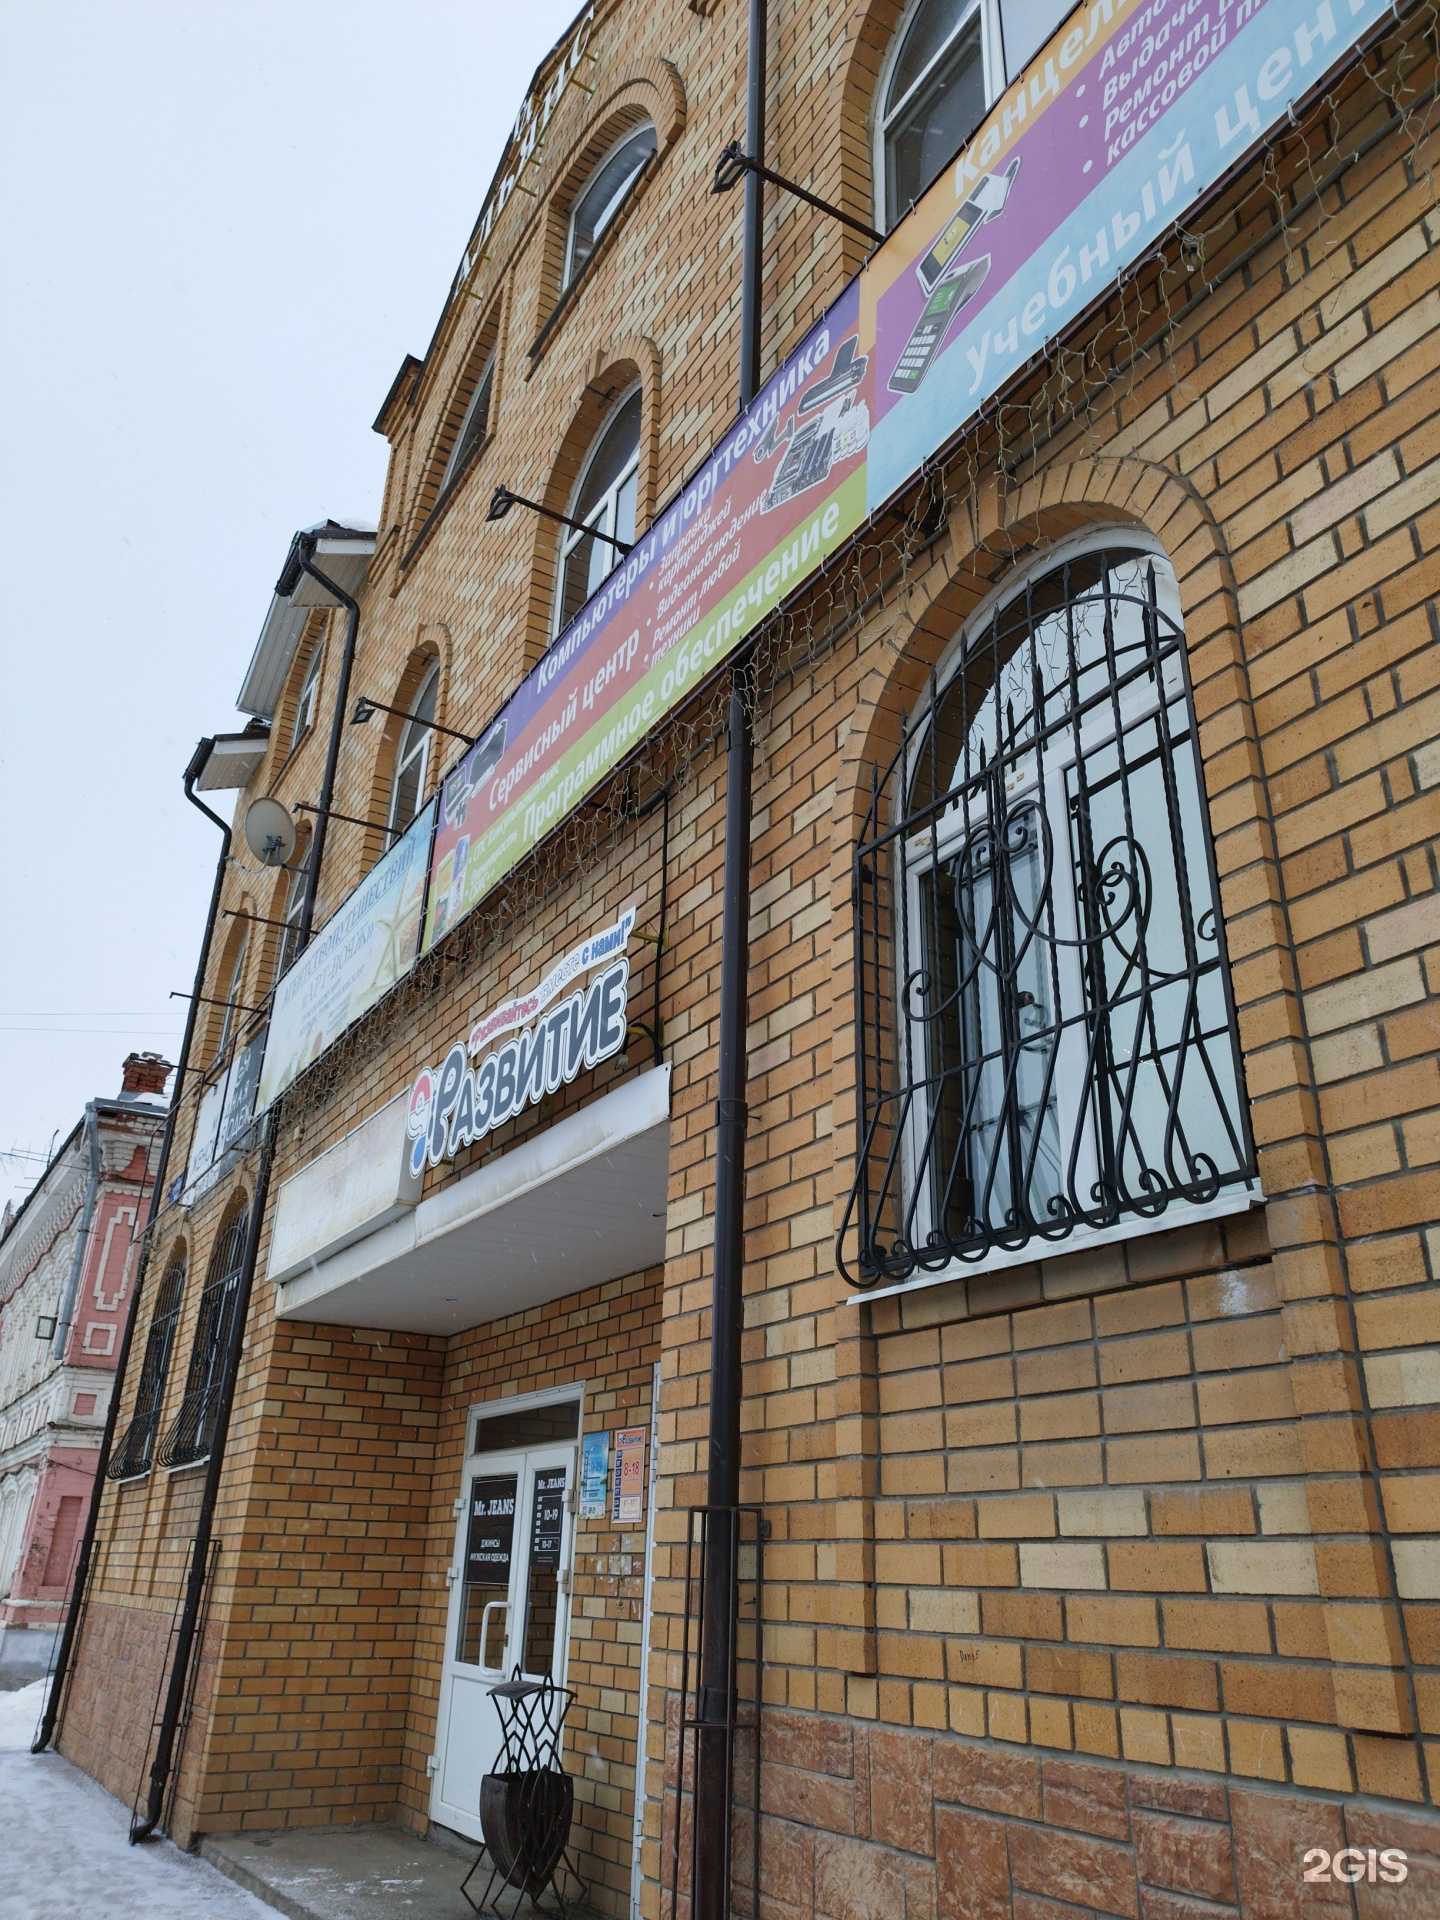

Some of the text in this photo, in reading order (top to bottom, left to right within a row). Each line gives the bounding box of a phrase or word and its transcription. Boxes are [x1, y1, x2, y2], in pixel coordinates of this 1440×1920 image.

[955, 0, 1126, 197] Канцел
[1104, 13, 1209, 142] Ремонт
[1107, 14, 1227, 167] кассовой
[966, 0, 1396, 395] учебный цен
[537, 329, 831, 694] Компьютеры и оргтехника
[658, 496, 732, 593] картриджей
[651, 606, 700, 668] техники
[652, 538, 741, 648] Ремонт любой
[489, 687, 578, 811] Сервисный
[581, 629, 640, 710] центр
[522, 501, 840, 842] Программное обеспечение
[474, 1498, 514, 1516] Mr. JEANS
[547, 1478, 565, 1489] JEANS
